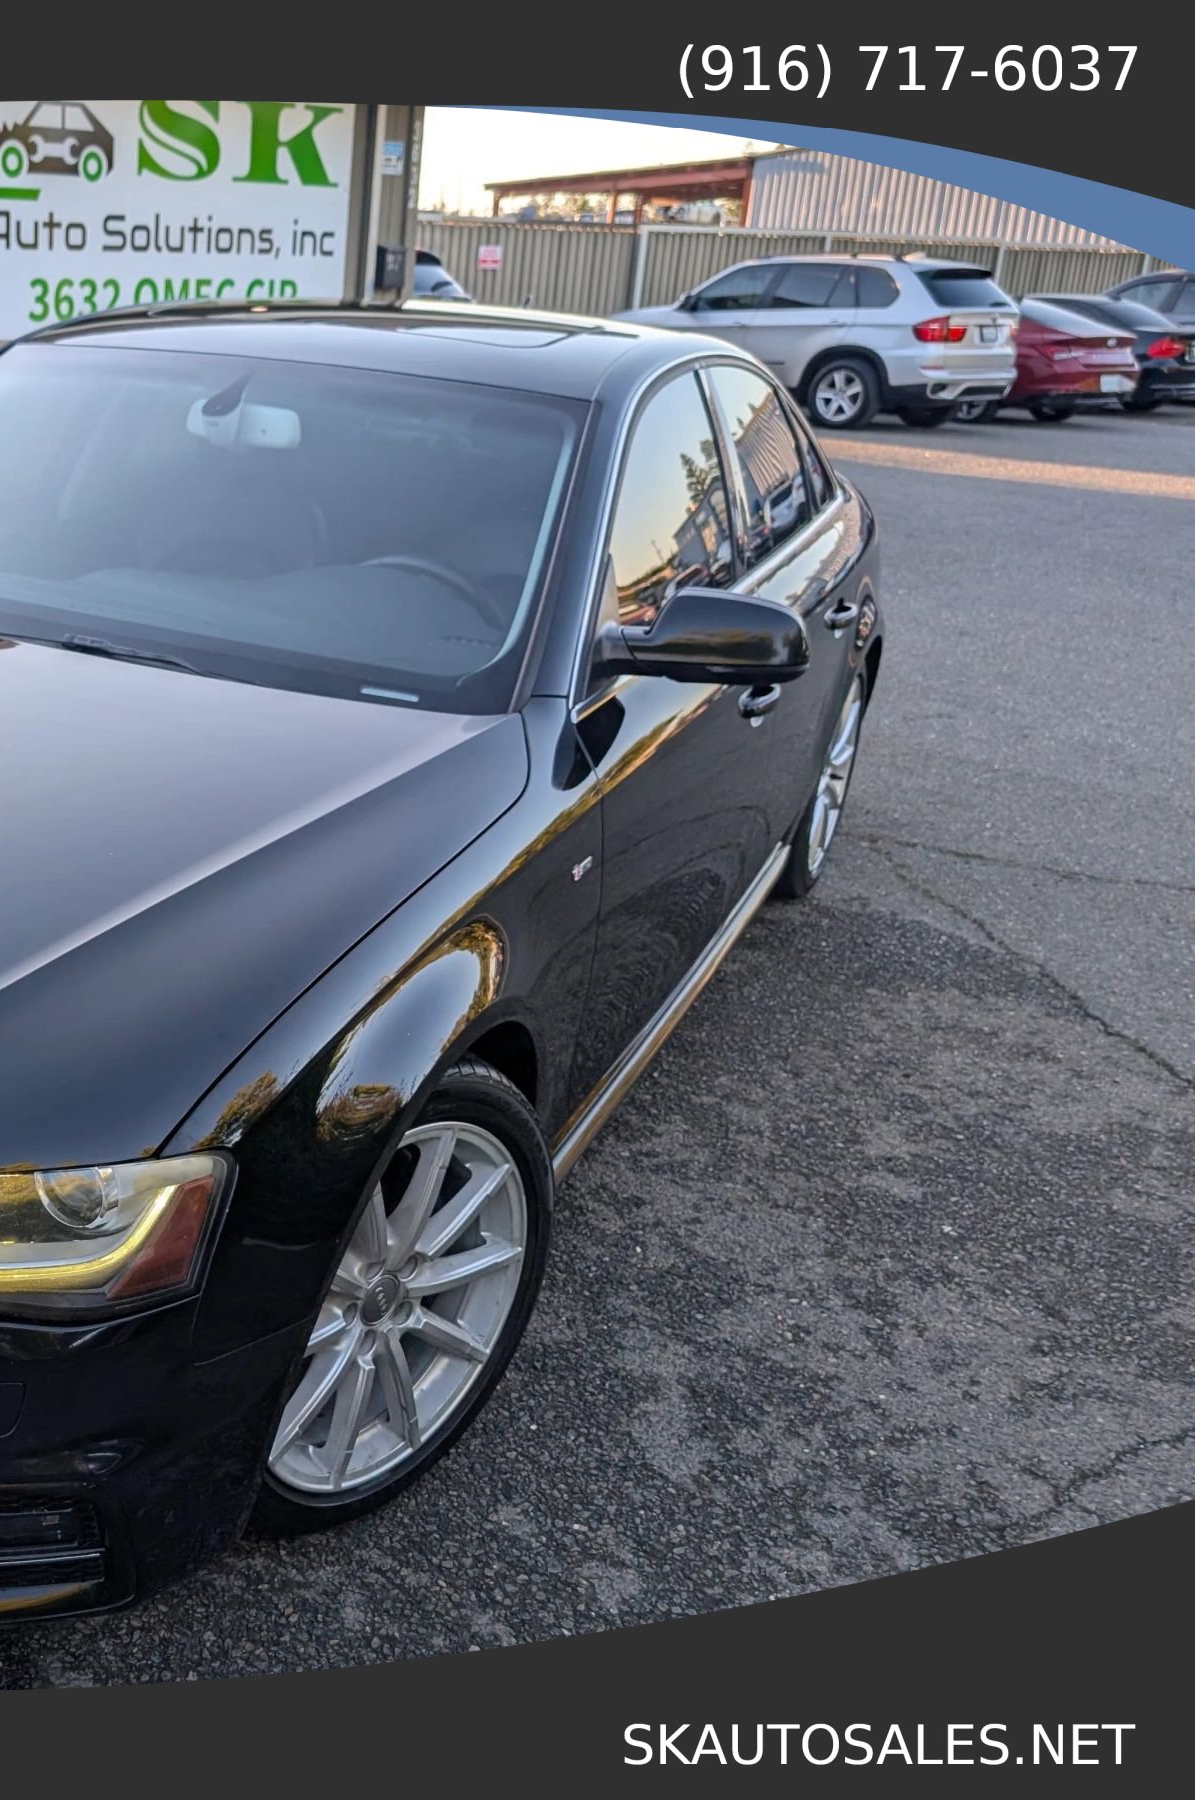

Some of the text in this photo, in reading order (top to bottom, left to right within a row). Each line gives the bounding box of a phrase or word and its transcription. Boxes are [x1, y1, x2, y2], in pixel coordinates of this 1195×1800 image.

[137, 100, 344, 187] SK
[101, 213, 281, 260] Solutions,
[290, 221, 335, 258] inc
[28, 277, 121, 322] 3632
